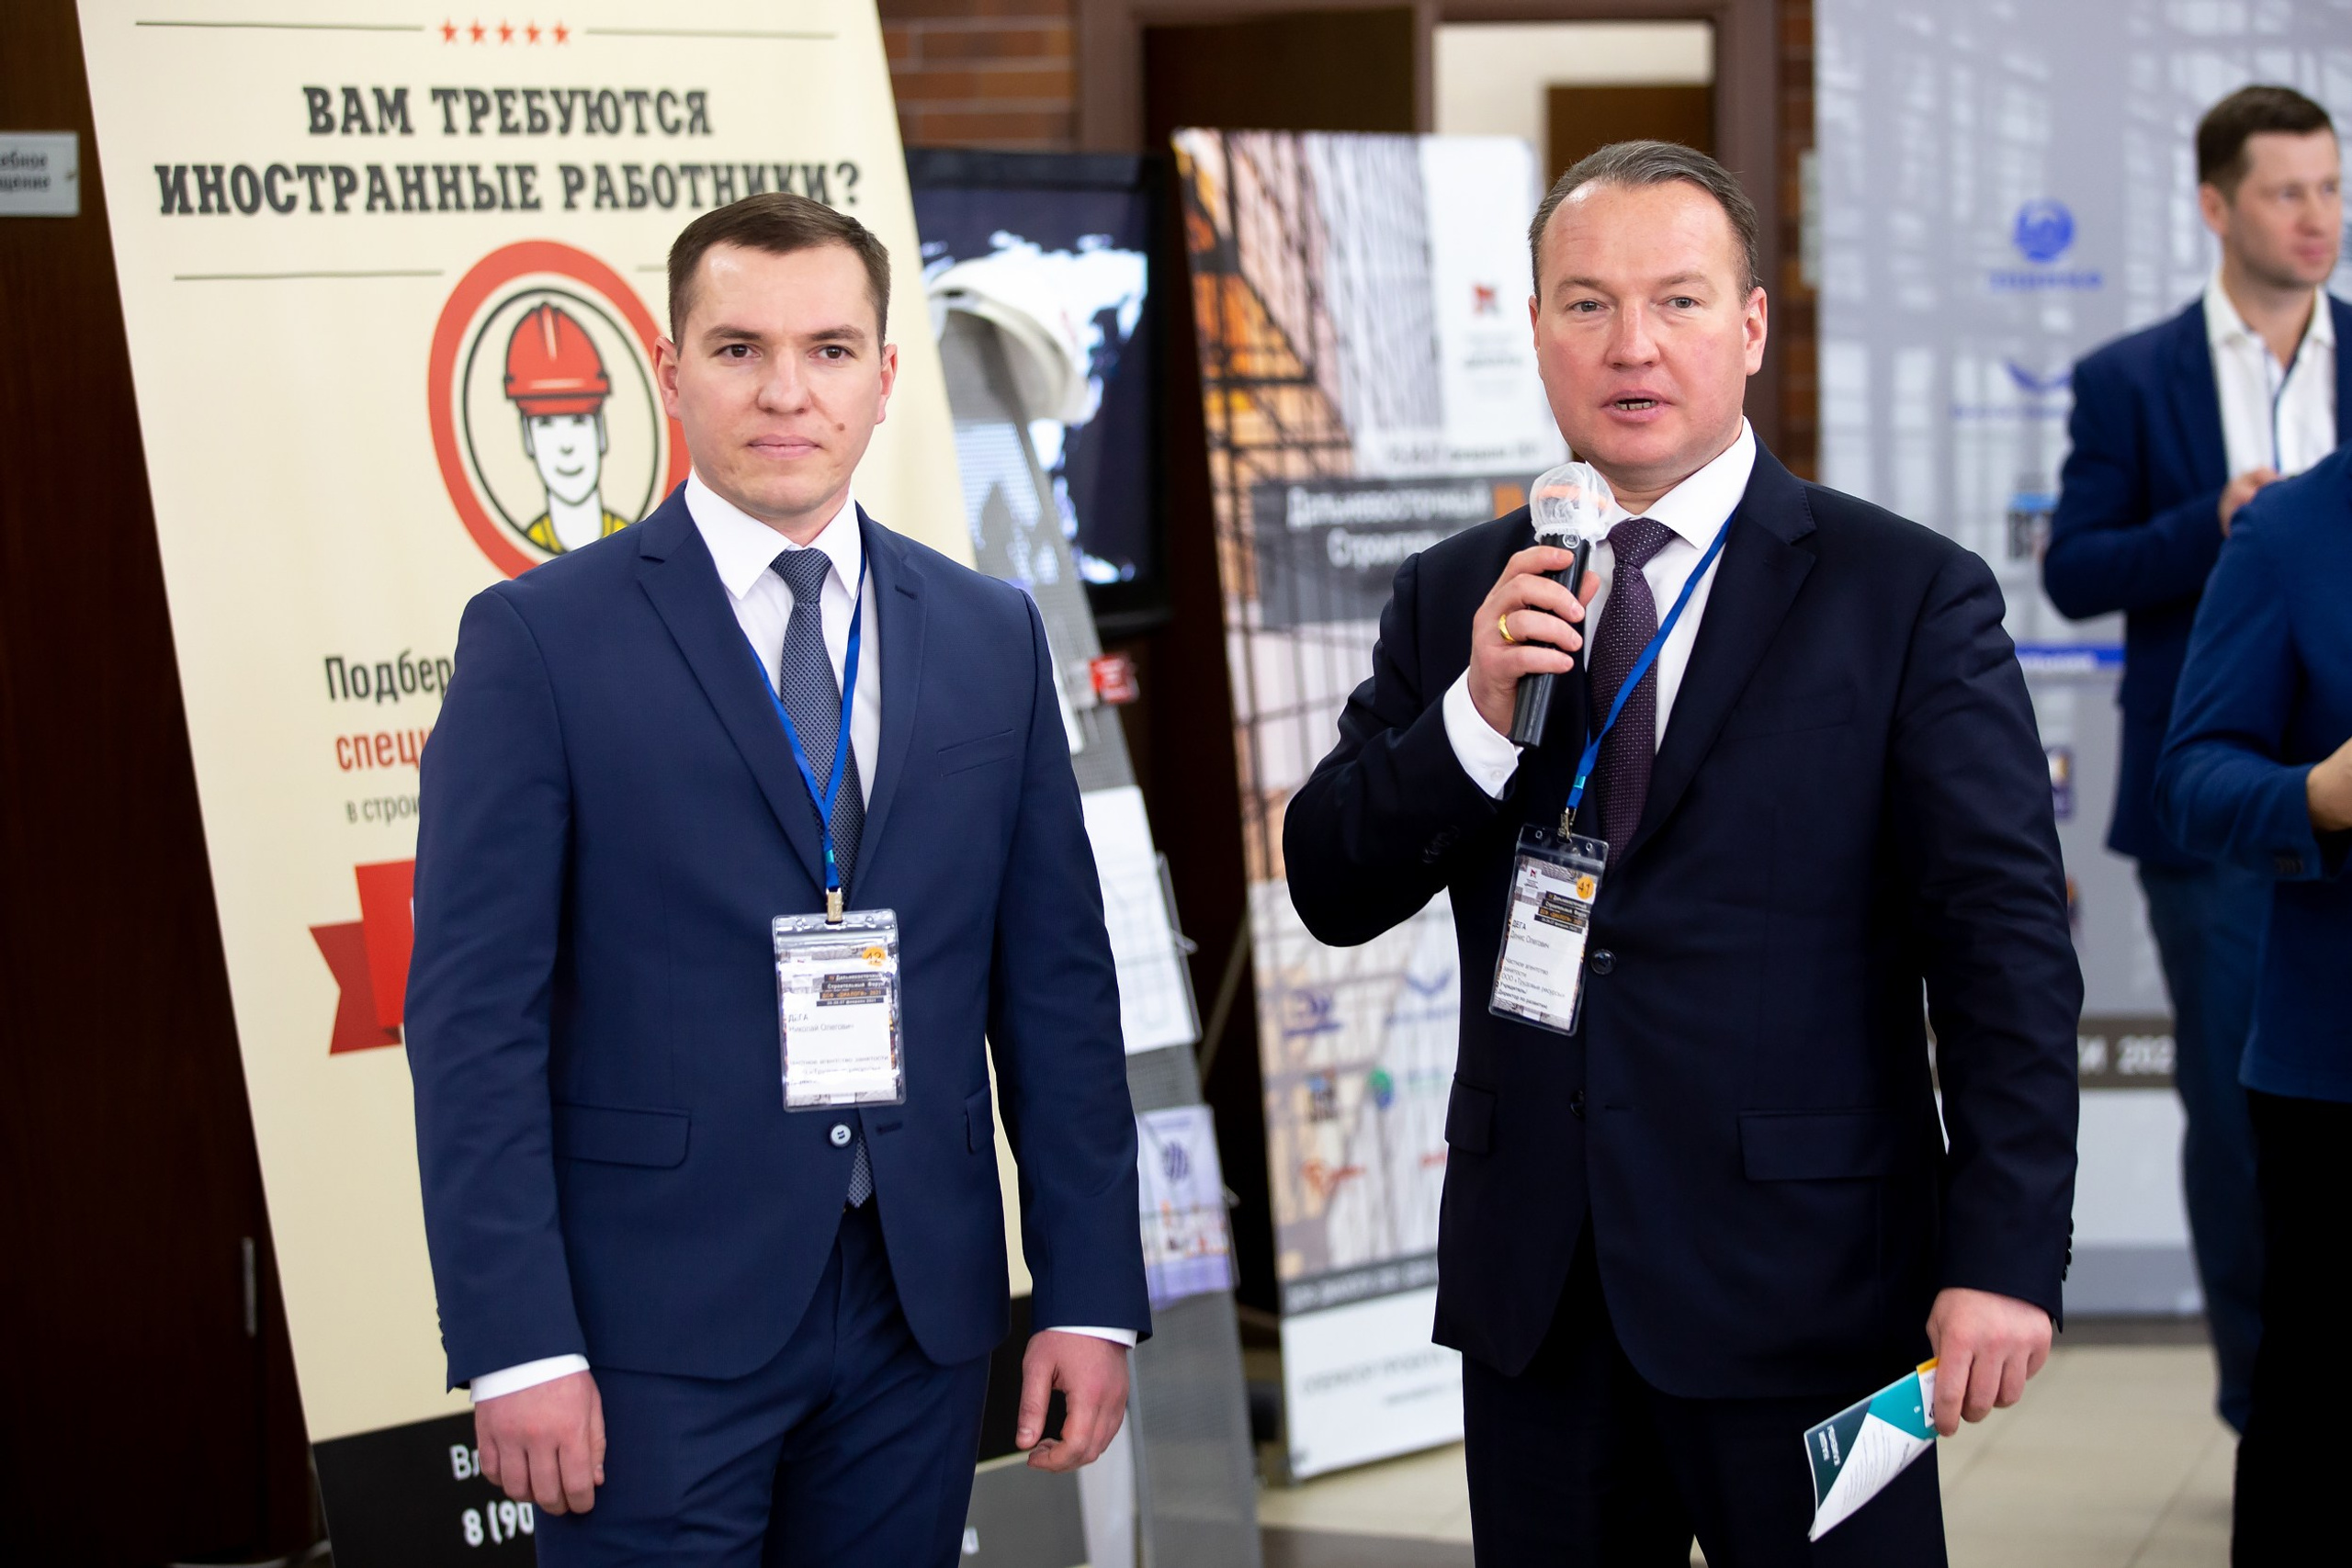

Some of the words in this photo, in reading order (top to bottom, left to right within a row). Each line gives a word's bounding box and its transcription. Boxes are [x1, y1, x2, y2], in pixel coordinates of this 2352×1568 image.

[301, 85, 414, 135] ВАМ
[431, 87, 712, 136] ТРЕБУЮТСЯ
[153, 163, 542, 216] ИНОСТРАННЫЕ
[558, 161, 862, 210] РАБОТНИКИ?
[324, 648, 453, 705] Подбер
[345, 801, 358, 823] в
[461, 1507, 484, 1547] 8
